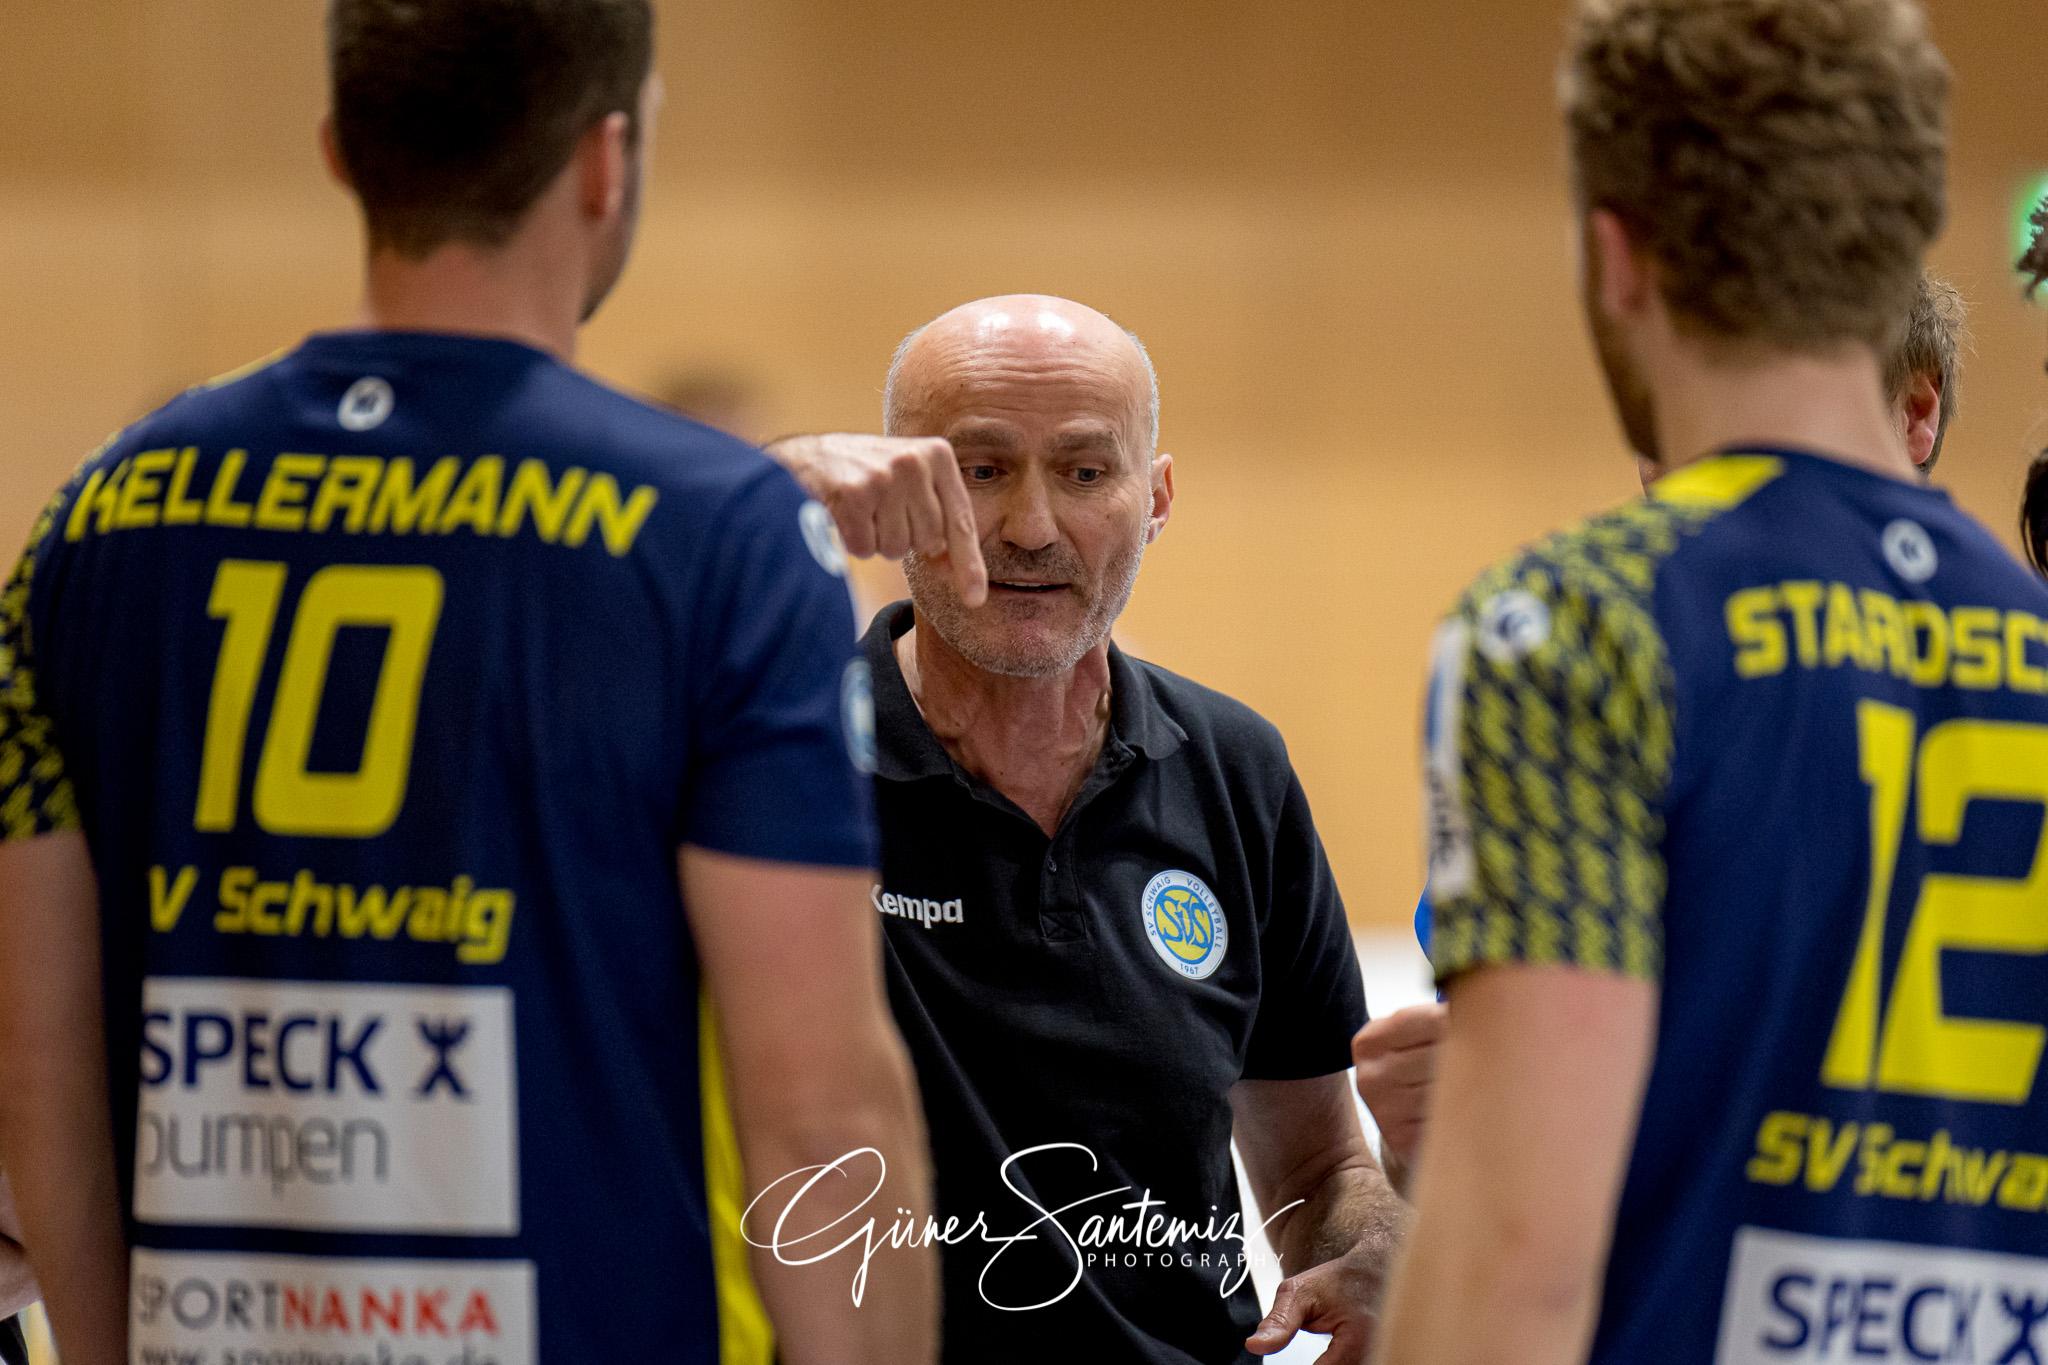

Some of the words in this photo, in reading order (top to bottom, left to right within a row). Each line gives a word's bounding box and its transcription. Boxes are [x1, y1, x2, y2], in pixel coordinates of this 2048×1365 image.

[1724, 579, 2048, 695] STAROSC
[194, 558, 445, 839] 10
[148, 864, 199, 933] V
[213, 866, 515, 964] Schwaig
[1145, 876, 1171, 917] SCHWAIG
[1148, 921, 1157, 936] SV
[1186, 878, 1223, 949] VOLLEYBALL
[1819, 697, 2048, 1106] 12
[1180, 963, 1199, 975] 1967
[141, 1009, 383, 1096] SPECK
[1745, 1110, 1860, 1193] SV
[1853, 1121, 2048, 1213] Schwa
